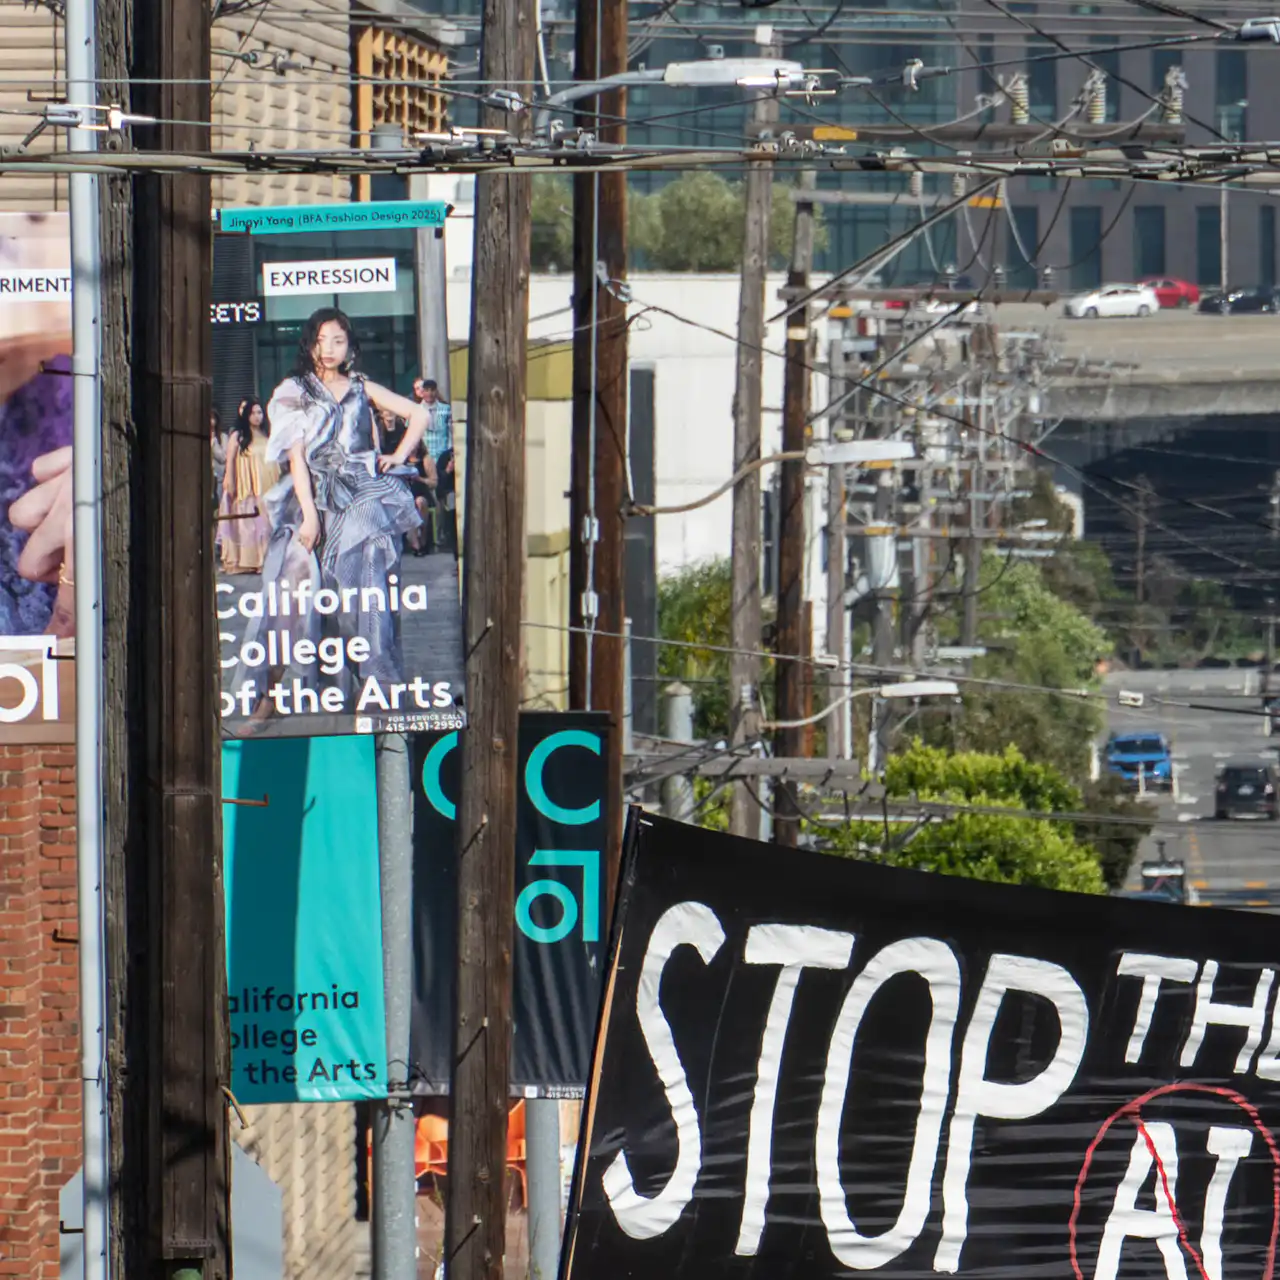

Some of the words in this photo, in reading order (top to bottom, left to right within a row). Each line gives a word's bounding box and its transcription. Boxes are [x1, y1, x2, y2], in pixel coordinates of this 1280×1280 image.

[229, 217, 264, 230] Jingyi
[265, 216, 294, 228] Yang
[298, 213, 322, 226] (BFA
[325, 211, 368, 224] Fashion
[371, 210, 409, 225] Design
[411, 209, 442, 222] 2025)
[270, 267, 390, 287] EXPRESSION
[215, 574, 428, 620] California
[219, 630, 371, 676] College
[220, 679, 256, 718] of
[269, 678, 346, 715] the
[356, 675, 454, 712] Arts
[385, 720, 464, 732] 415-431-2950
[229, 984, 359, 1013] alifornia
[230, 1024, 317, 1055] ollege
[243, 1059, 298, 1084] the
[308, 1058, 377, 1082] Arts
[602, 900, 1089, 1275] STOP
